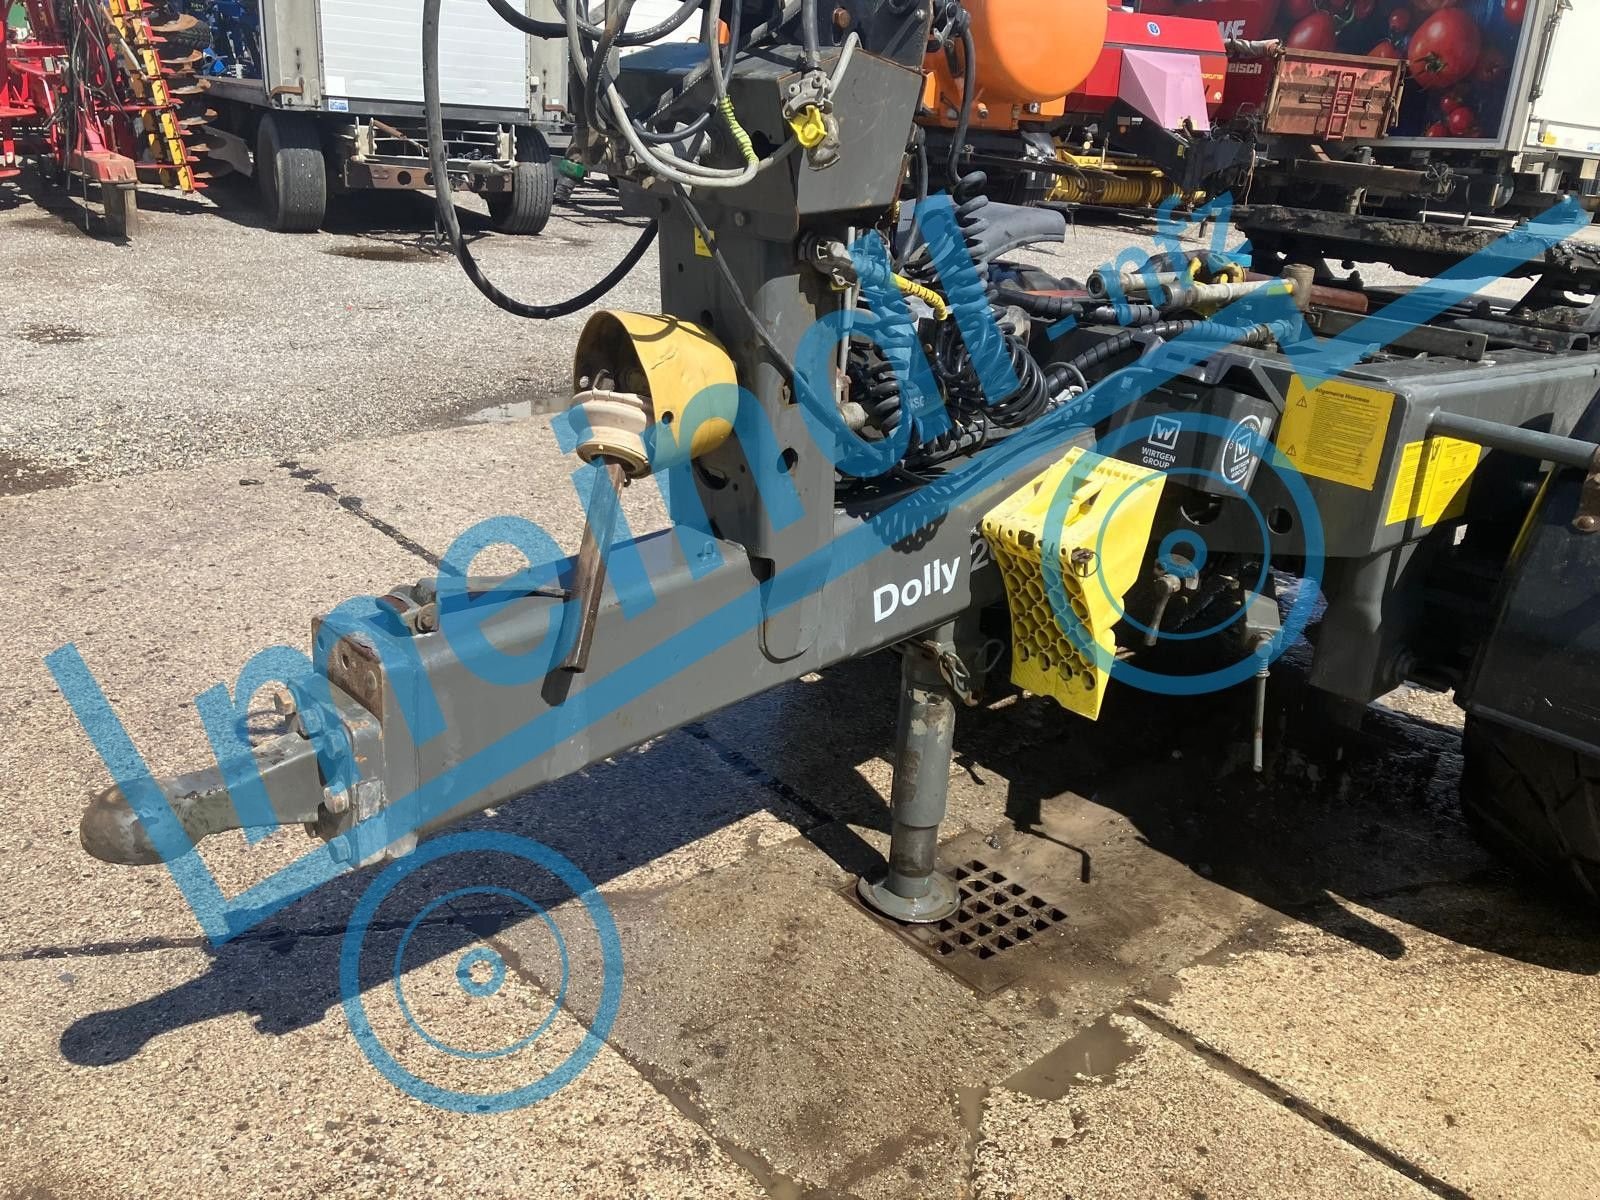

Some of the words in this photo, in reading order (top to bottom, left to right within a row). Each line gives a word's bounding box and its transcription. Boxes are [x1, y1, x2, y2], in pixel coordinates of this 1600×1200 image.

[1141, 446, 1176, 463] WIRTGEN
[1142, 456, 1170, 470] GROUP
[873, 556, 961, 623] Dolly
[970, 537, 997, 573] 2
